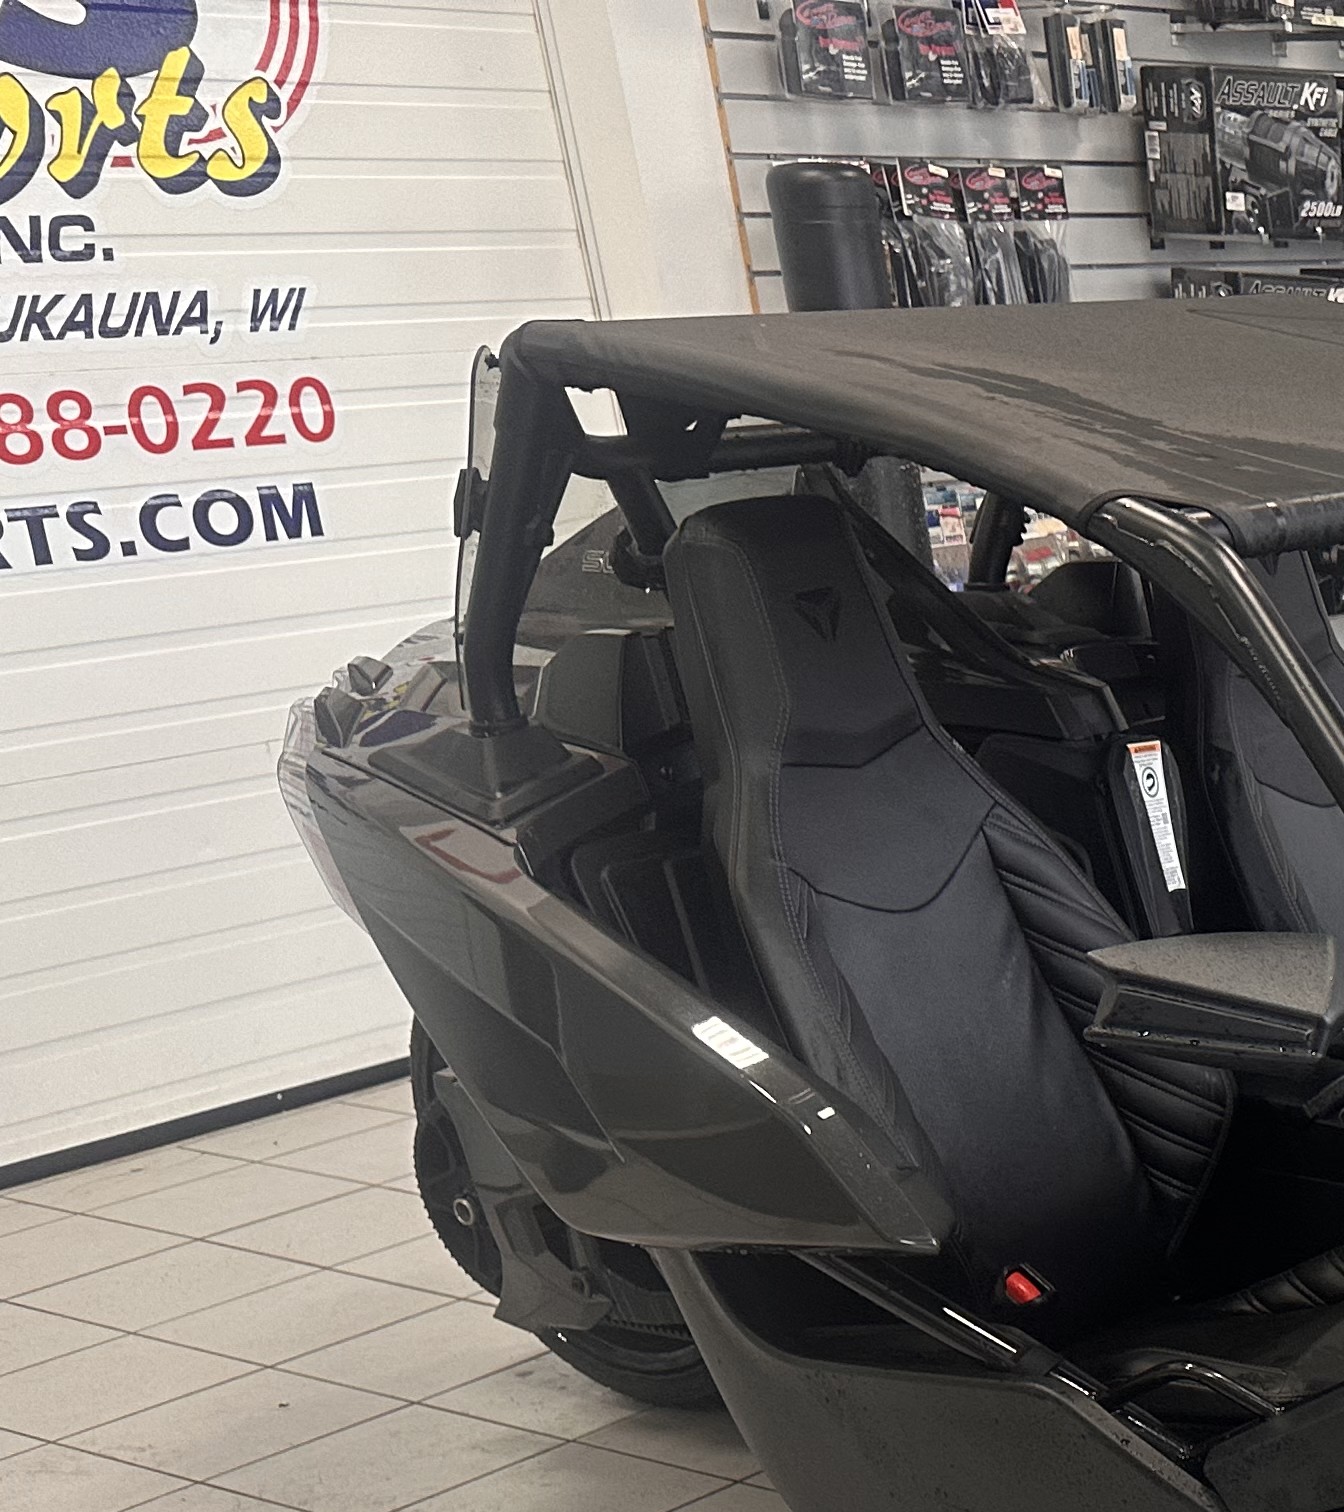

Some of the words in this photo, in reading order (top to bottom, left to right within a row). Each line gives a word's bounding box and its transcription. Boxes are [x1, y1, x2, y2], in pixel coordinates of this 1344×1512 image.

[1214, 75, 1301, 107] ASSAULT
[249, 286, 307, 333] WI
[0, 376, 336, 466] 88-0220
[0, 481, 326, 570] TS.COM
